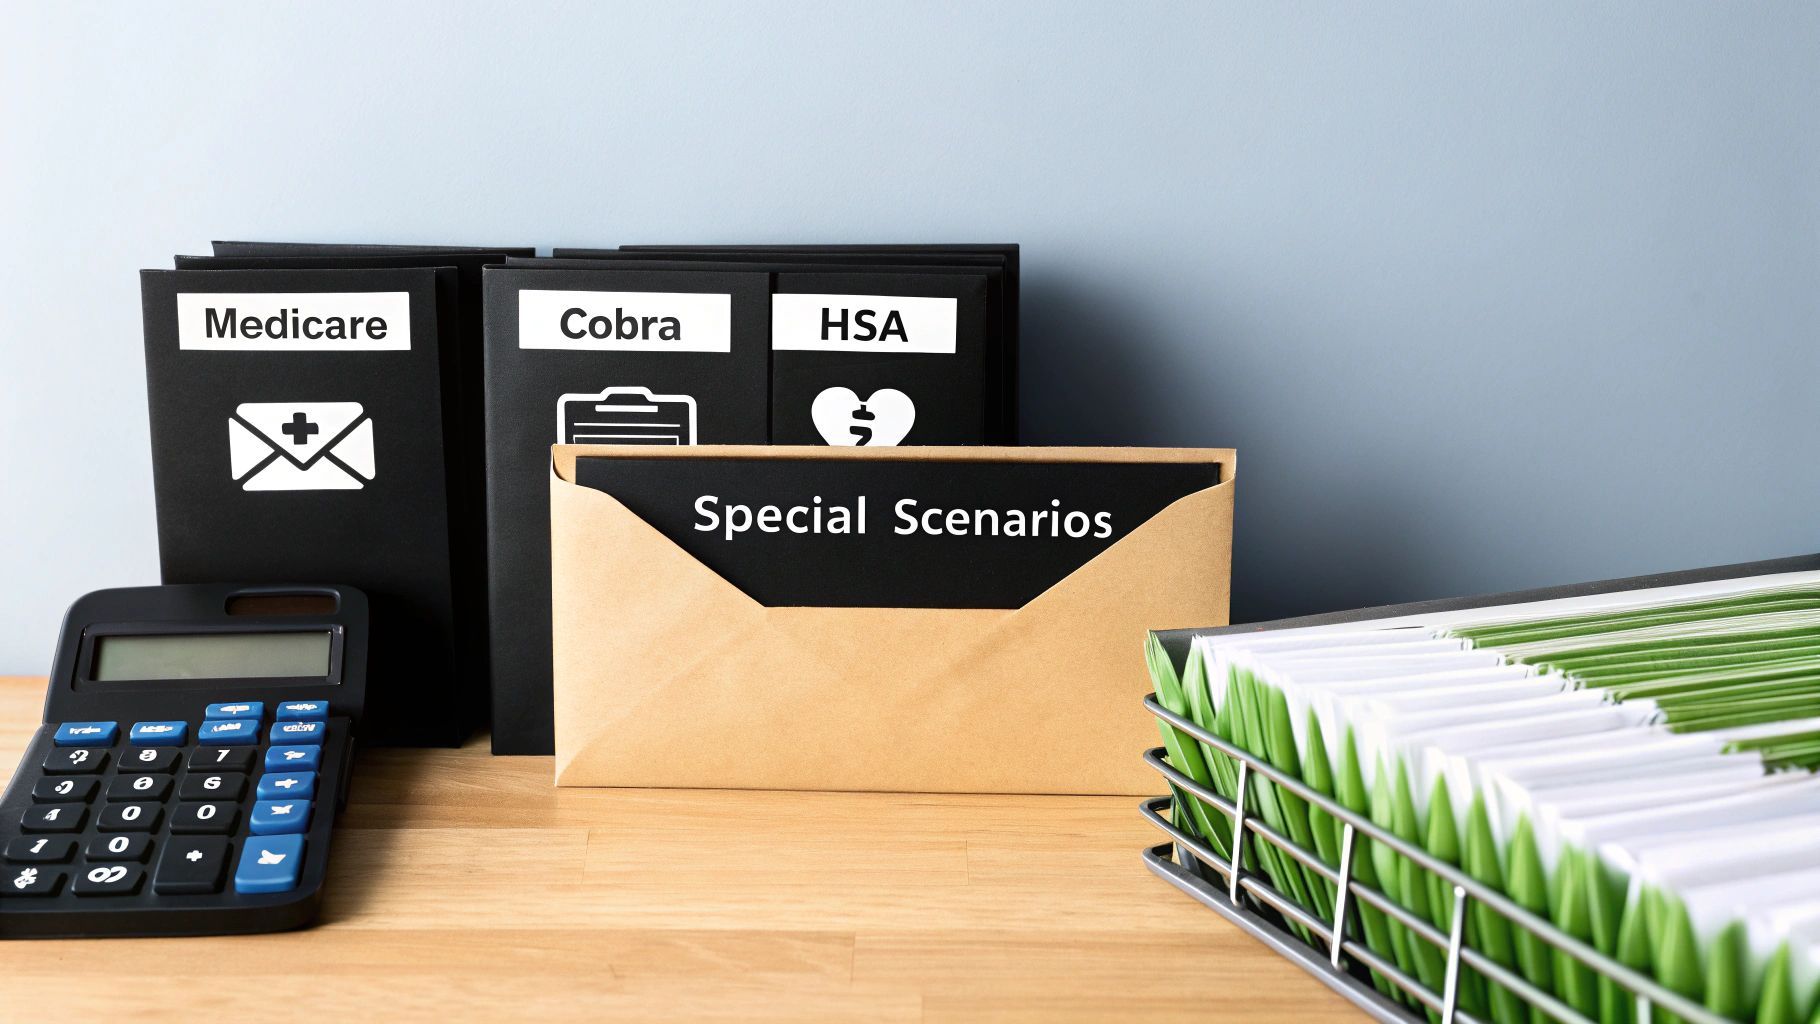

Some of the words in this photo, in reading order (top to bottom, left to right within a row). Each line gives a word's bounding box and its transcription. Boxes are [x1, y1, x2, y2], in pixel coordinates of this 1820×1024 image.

[205, 307, 388, 340] Medicare
[560, 307, 681, 341] Cobra
[820, 307, 909, 343] HSA
[693, 494, 867, 541] Special
[893, 498, 1113, 539] Scenarios
[216, 749, 231, 762] 7
[121, 805, 142, 821] 0
[196, 804, 216, 820] 0
[29, 838, 49, 854] 1
[108, 836, 130, 853] 0
